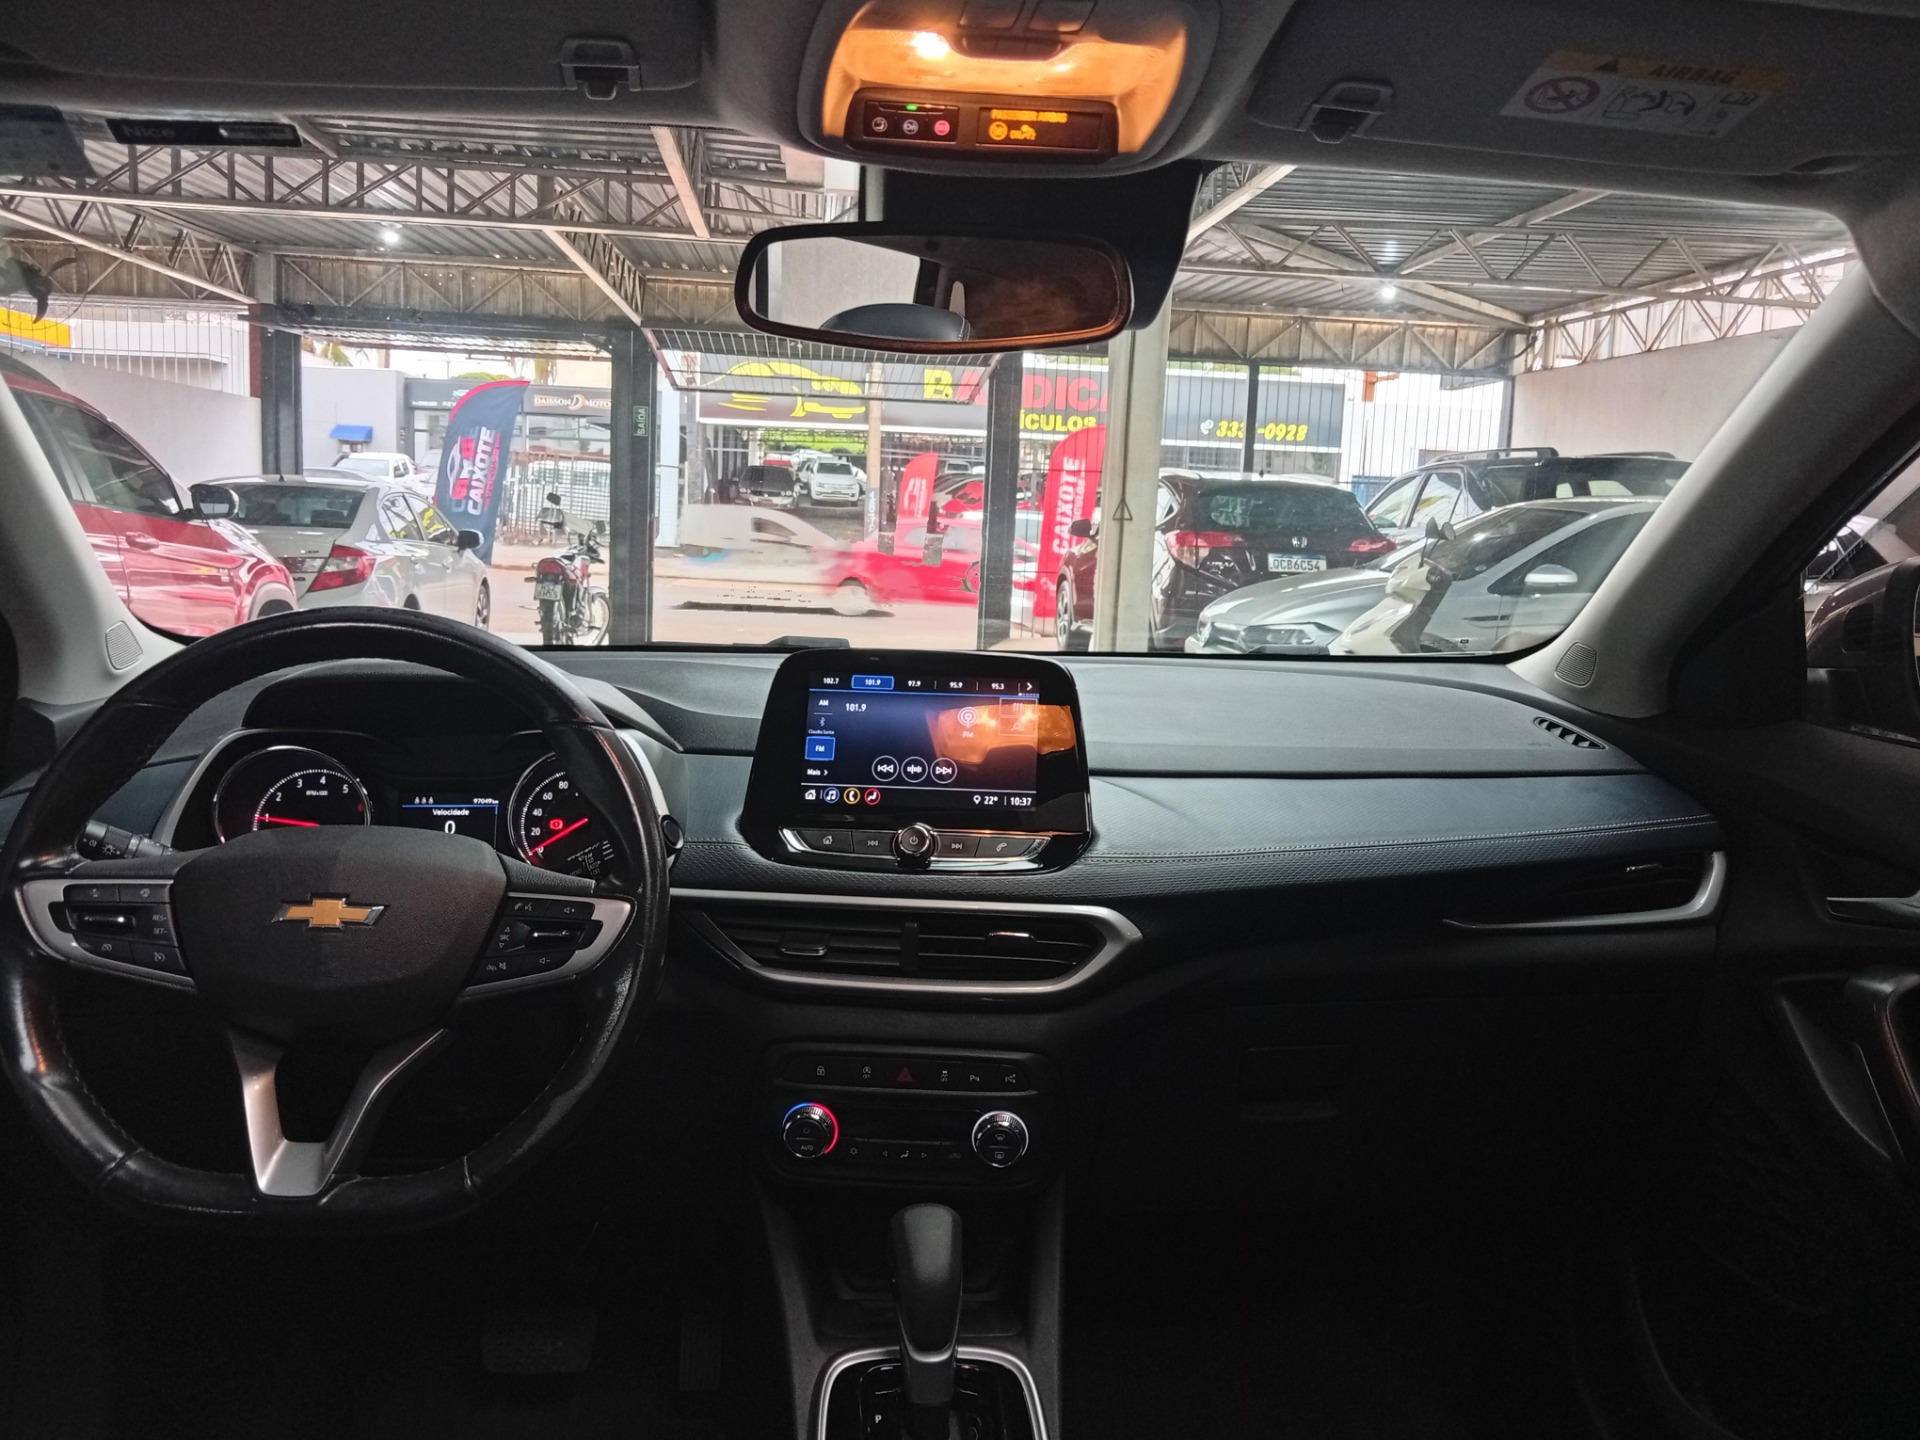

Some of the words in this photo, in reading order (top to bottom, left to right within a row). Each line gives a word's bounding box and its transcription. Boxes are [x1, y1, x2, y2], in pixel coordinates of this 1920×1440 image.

[636, 408, 647, 434] SAÍDA
[467, 426, 496, 515] CAIXOTE
[1053, 457, 1080, 555] CAIXOTE
[845, 703, 867, 712] 101.9
[296, 778, 303, 788] 3
[319, 776, 327, 784] 4
[342, 784, 349, 794] 5
[558, 781, 568, 789] 80
[275, 792, 282, 801] 2
[542, 792, 553, 800] 60
[1010, 796, 1032, 806] 10:37
[432, 808, 470, 816] Velocidade
[532, 808, 543, 817] 40
[444, 820, 456, 834] 0
[530, 827, 541, 836] 20
[875, 1414, 882, 1423] P
